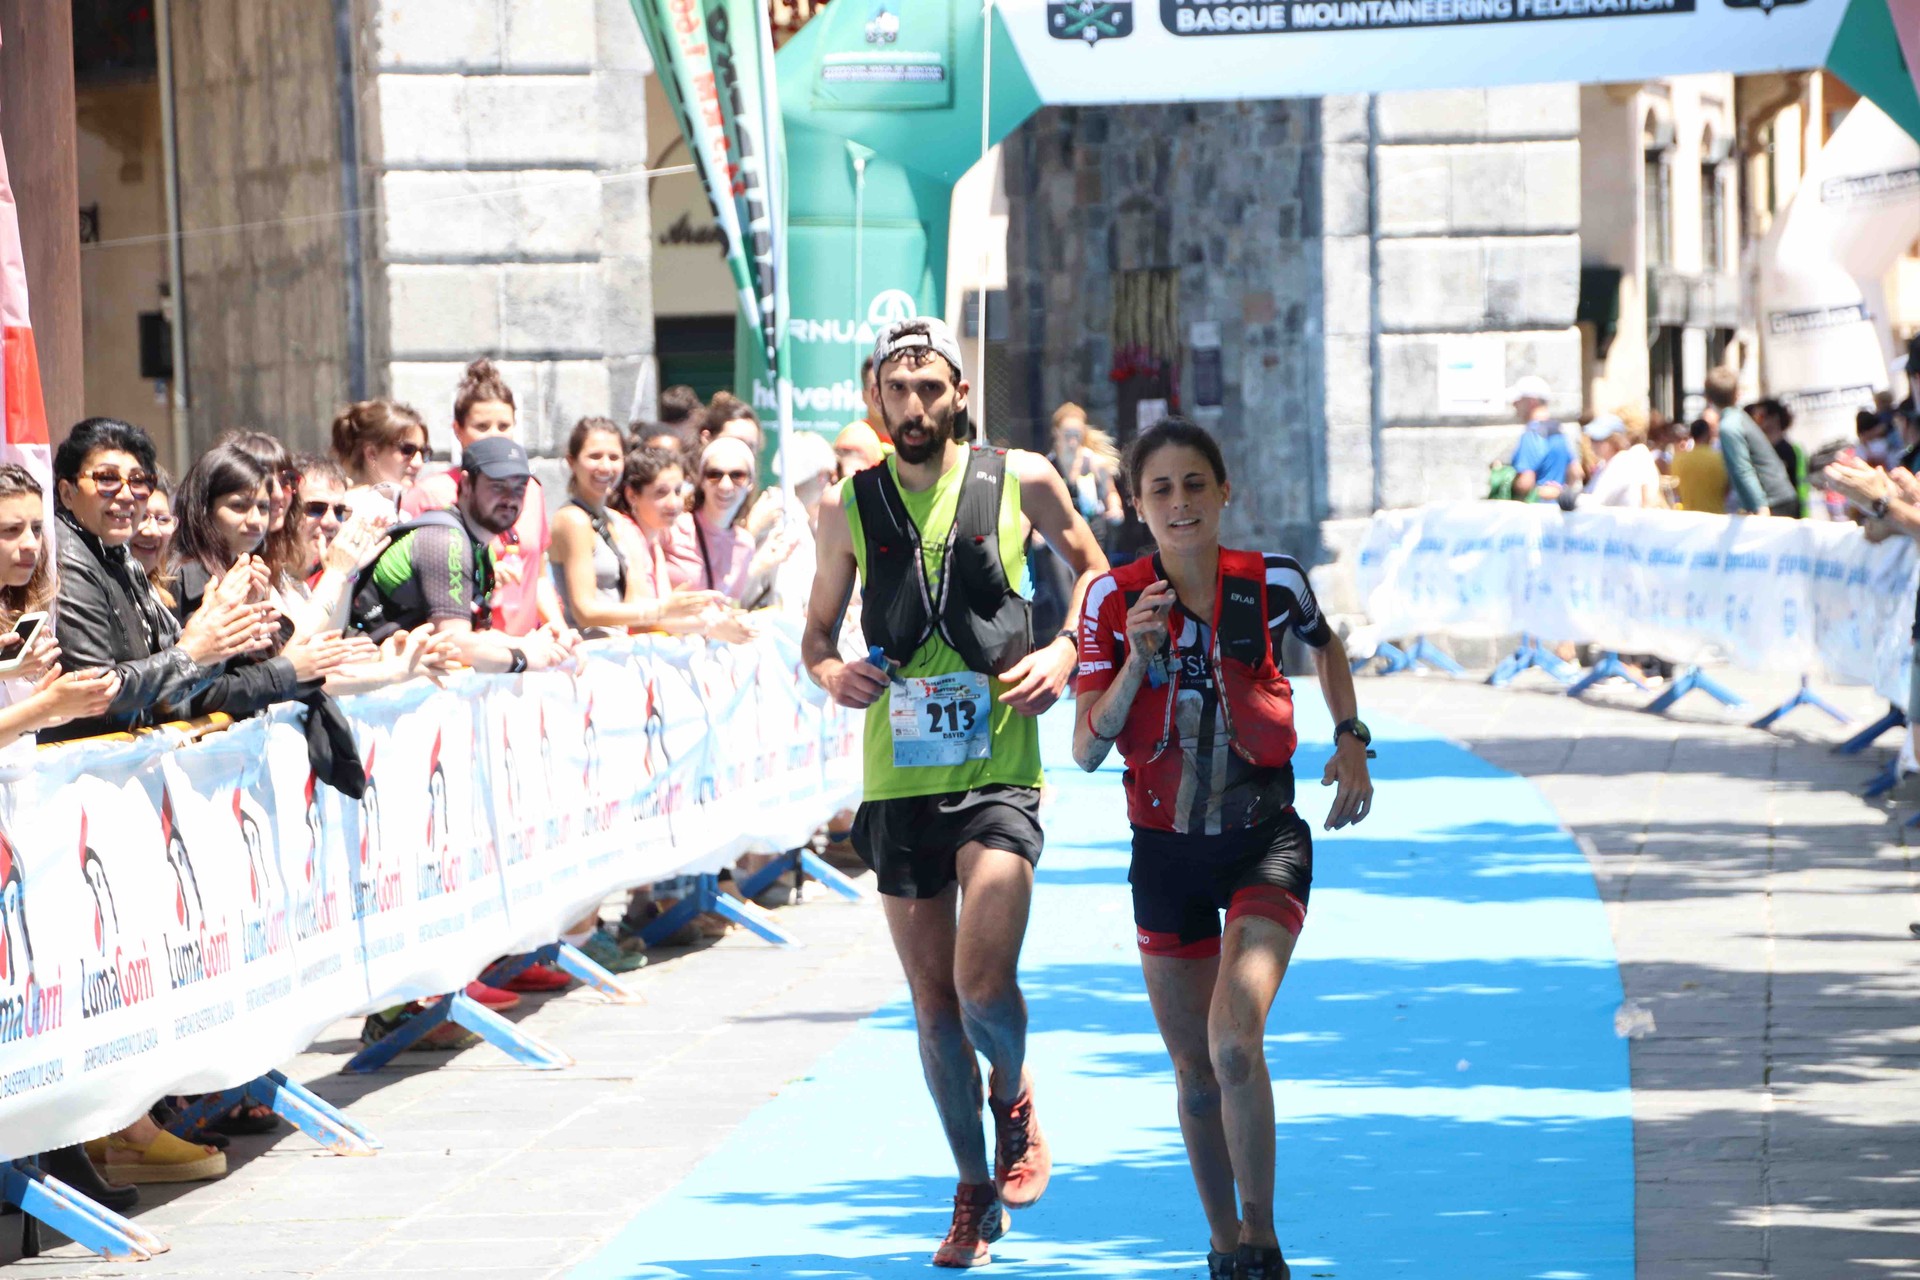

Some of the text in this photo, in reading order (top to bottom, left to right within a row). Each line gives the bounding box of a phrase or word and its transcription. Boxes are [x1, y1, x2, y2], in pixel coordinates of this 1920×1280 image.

[1176, 5, 1286, 32] BASQUE
[1291, 0, 1513, 28] MOUNTAINEERING
[926, 700, 977, 733] 213
[943, 732, 965, 740] DAVID
[163, 914, 231, 990] LumaGorri
[80, 938, 155, 1019] LumaGorri
